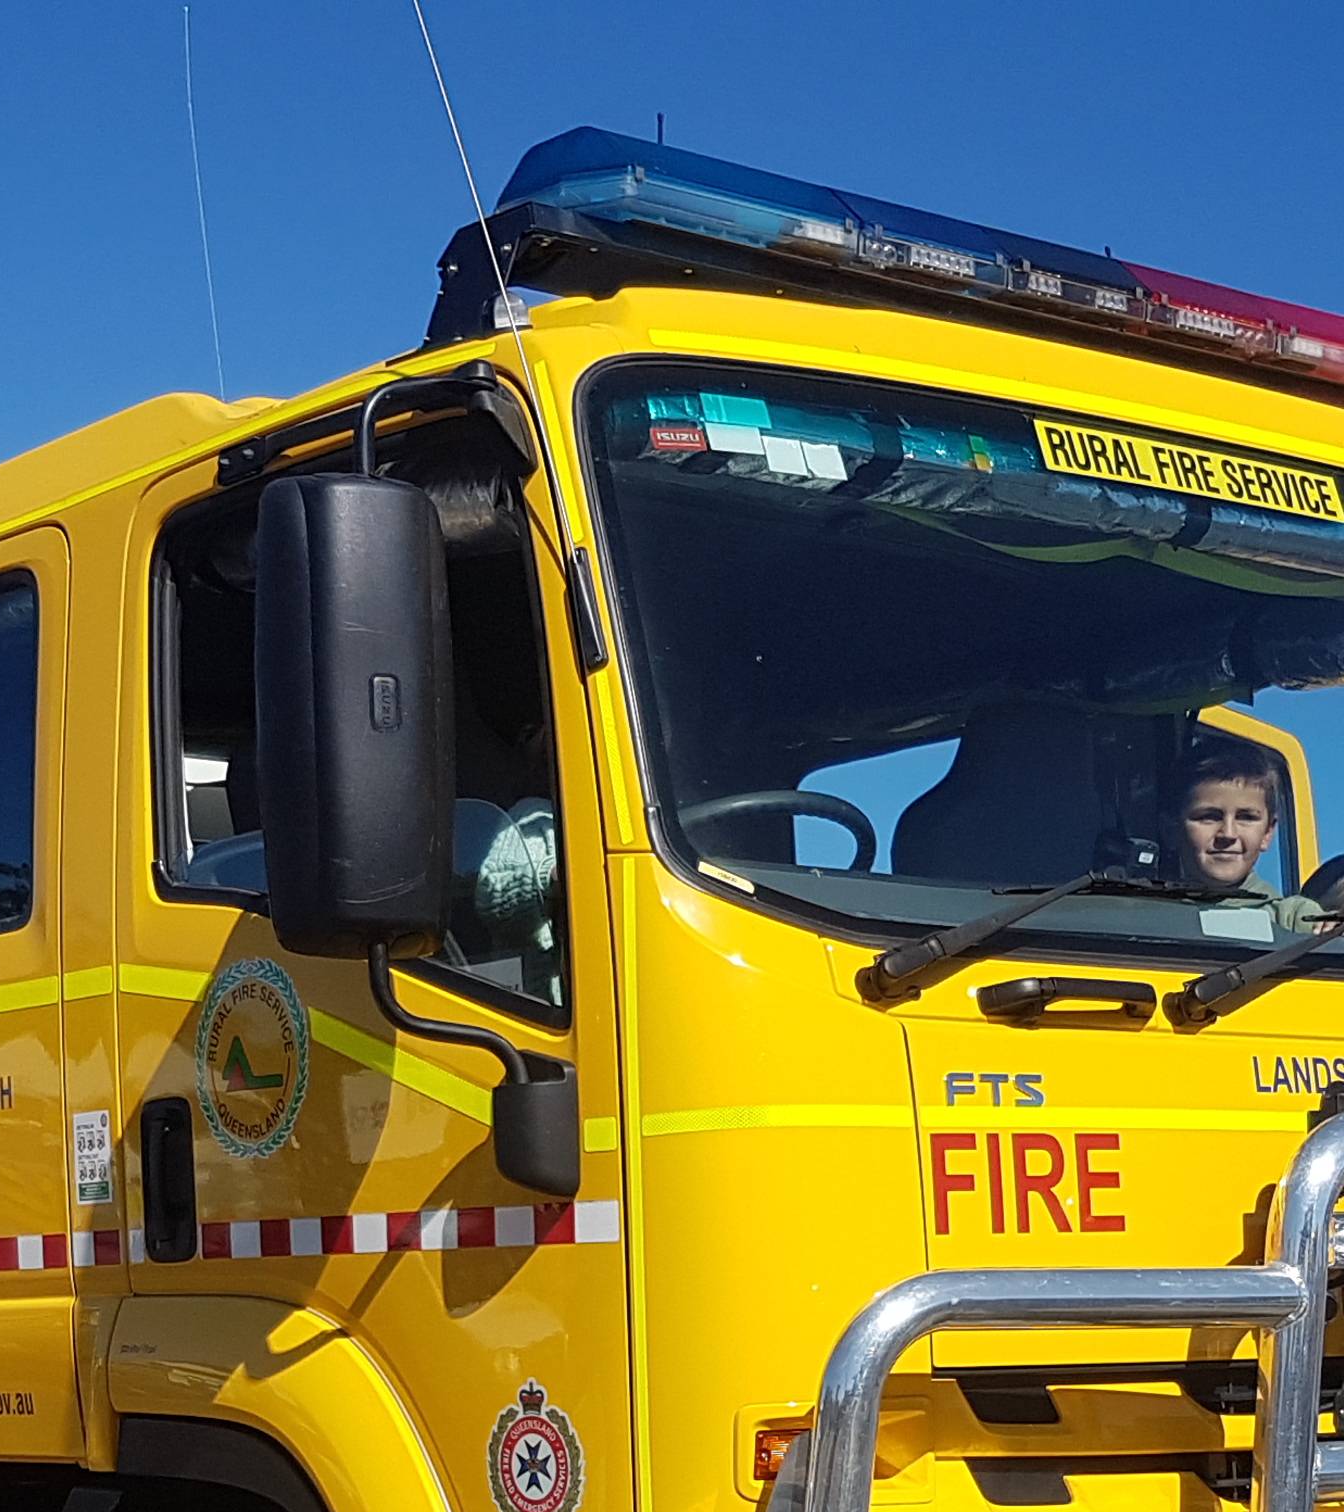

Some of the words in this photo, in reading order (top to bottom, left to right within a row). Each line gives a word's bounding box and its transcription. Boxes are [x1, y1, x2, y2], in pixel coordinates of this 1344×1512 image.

[656, 431, 700, 443] ISUZU
[1044, 427, 1151, 481] RURAL
[1152, 446, 1221, 494] FIRE
[1221, 460, 1337, 517] SERVICE
[208, 1004, 232, 1062] RURAL
[232, 984, 257, 1006] FIRE
[259, 986, 294, 1053] SERVICE
[945, 1073, 1044, 1107] FTS
[218, 1099, 286, 1139] QUEENSLAND
[930, 1133, 1126, 1235] FIRE
[511, 1420, 556, 1442] QUEENSLAND
[503, 1472, 515, 1493] AND
[553, 1451, 566, 1498] SERVICES
